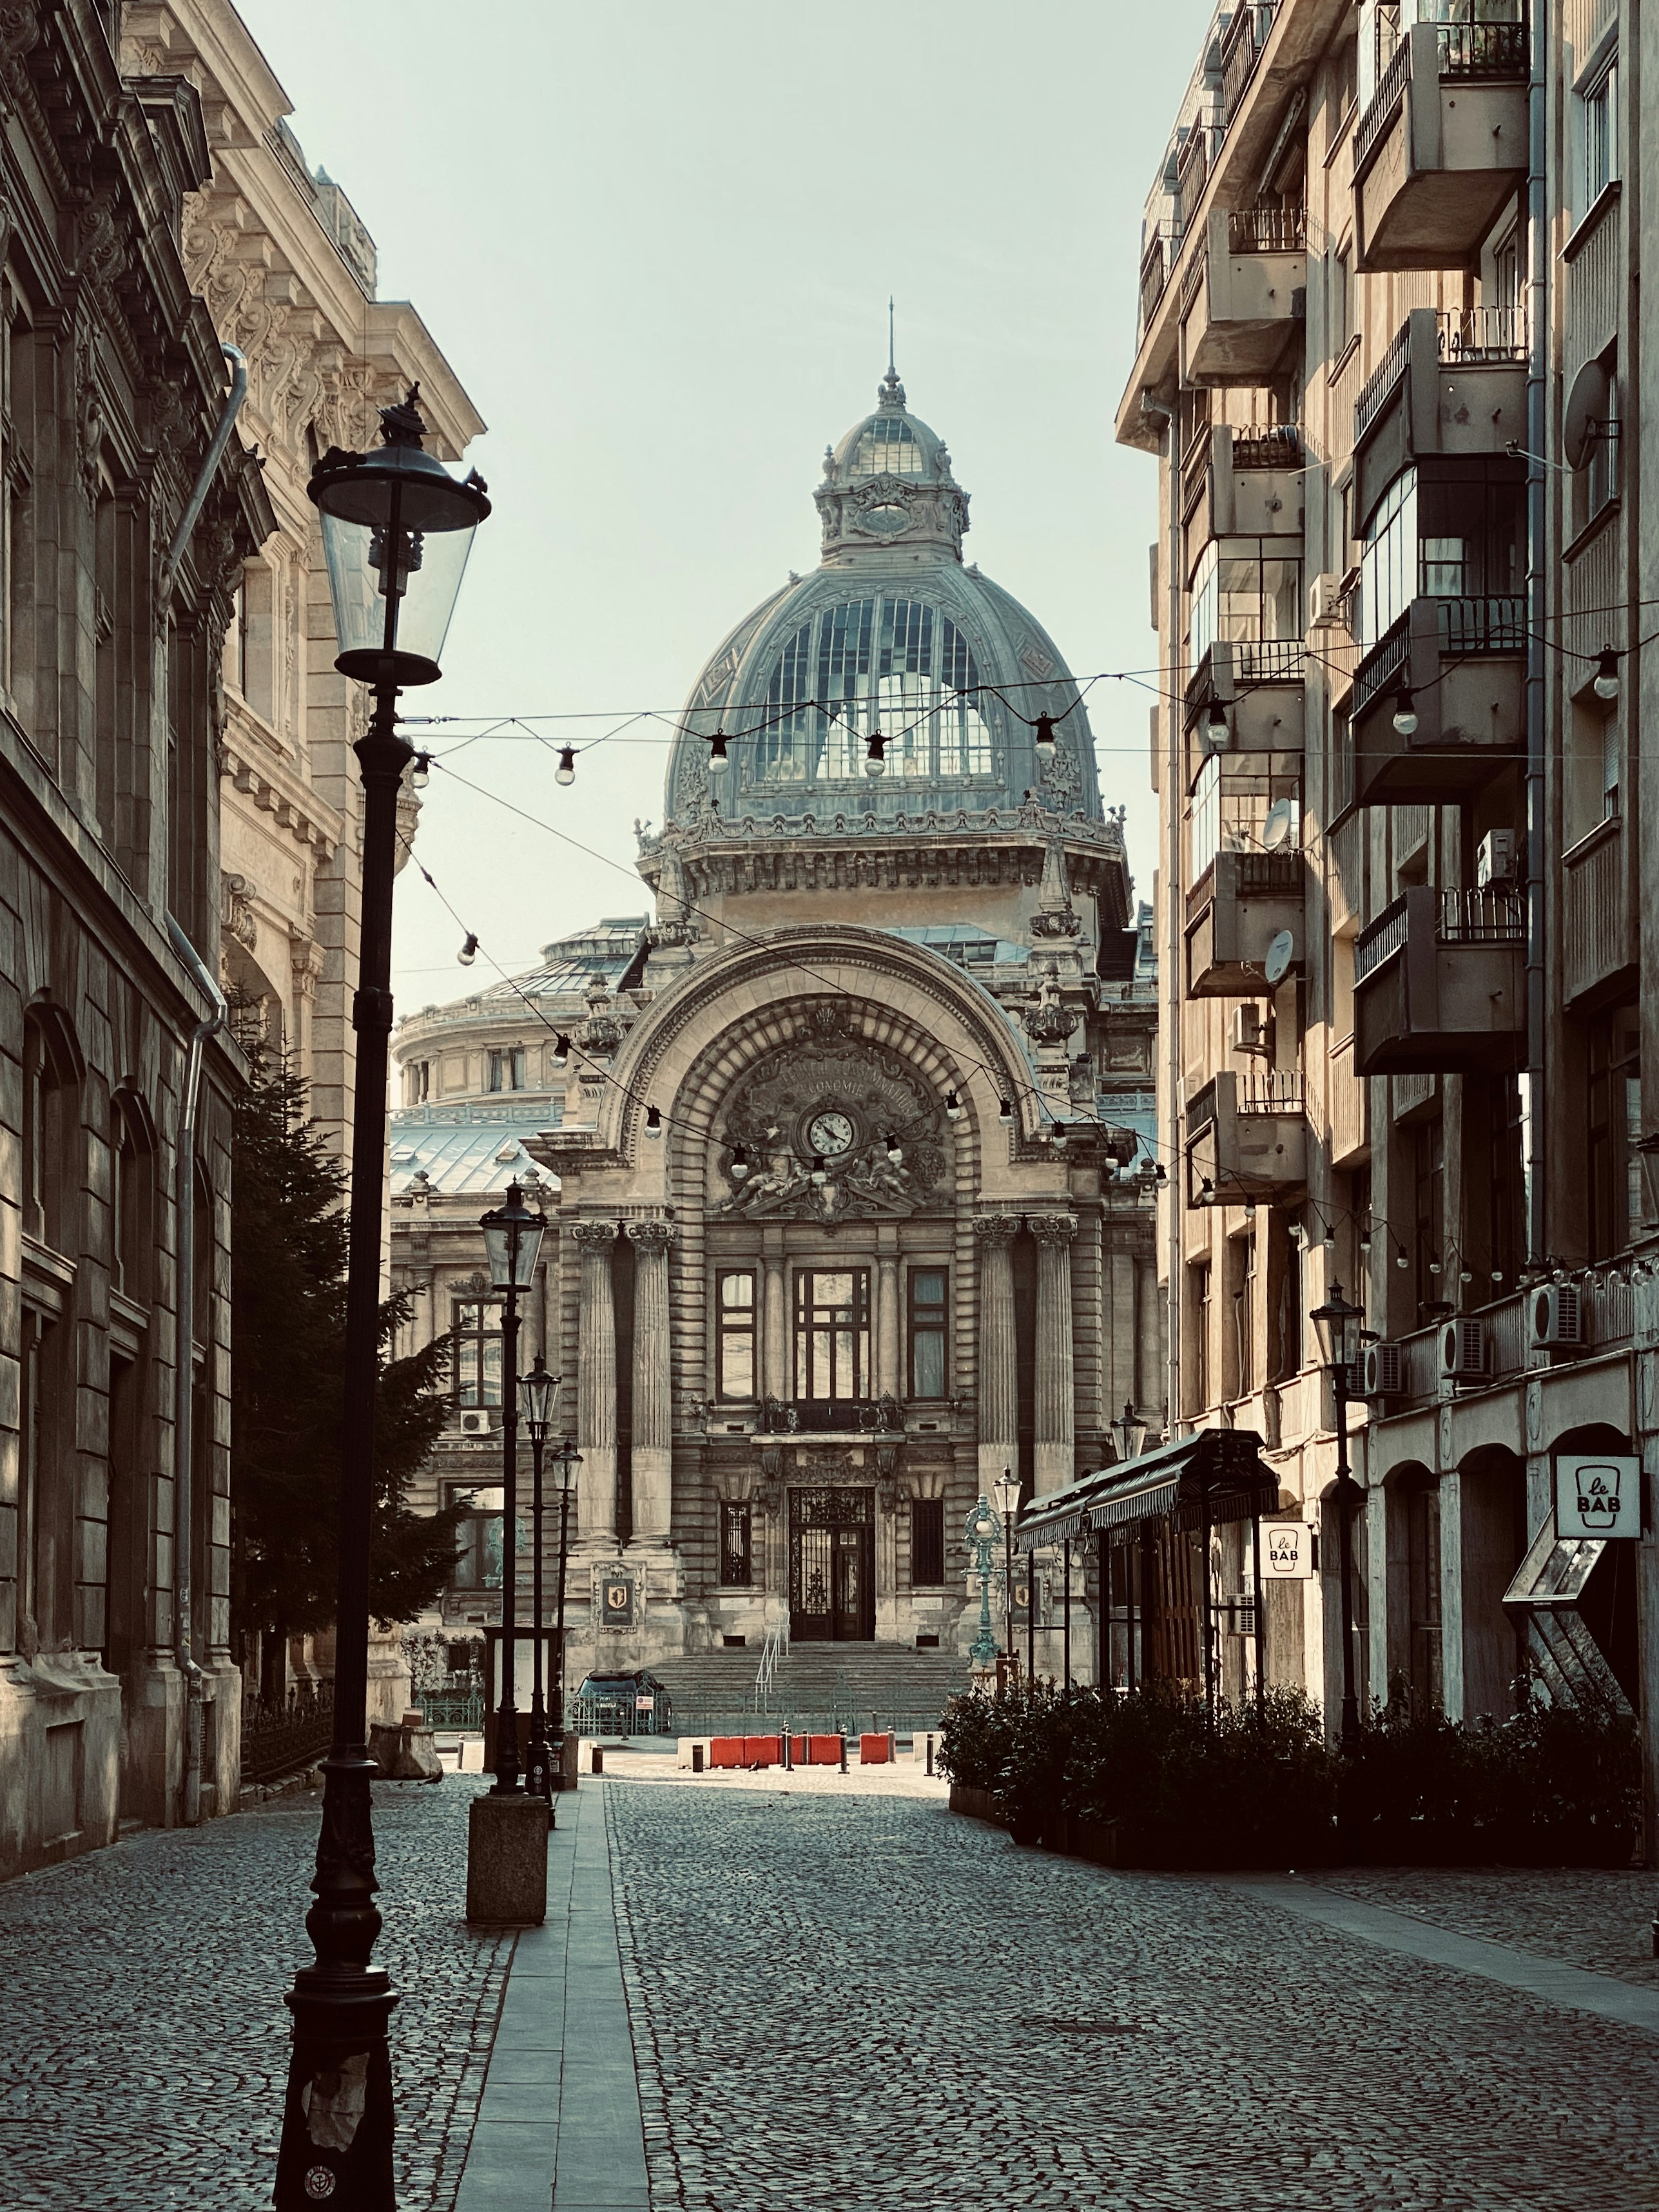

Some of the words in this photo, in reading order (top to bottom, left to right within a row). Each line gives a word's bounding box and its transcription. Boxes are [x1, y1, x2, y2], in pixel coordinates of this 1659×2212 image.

[1588, 1477, 1609, 1496] le
[1577, 1496, 1621, 1513] BAB
[1277, 1537, 1290, 1549] le
[1270, 1550, 1298, 1561] BAB
